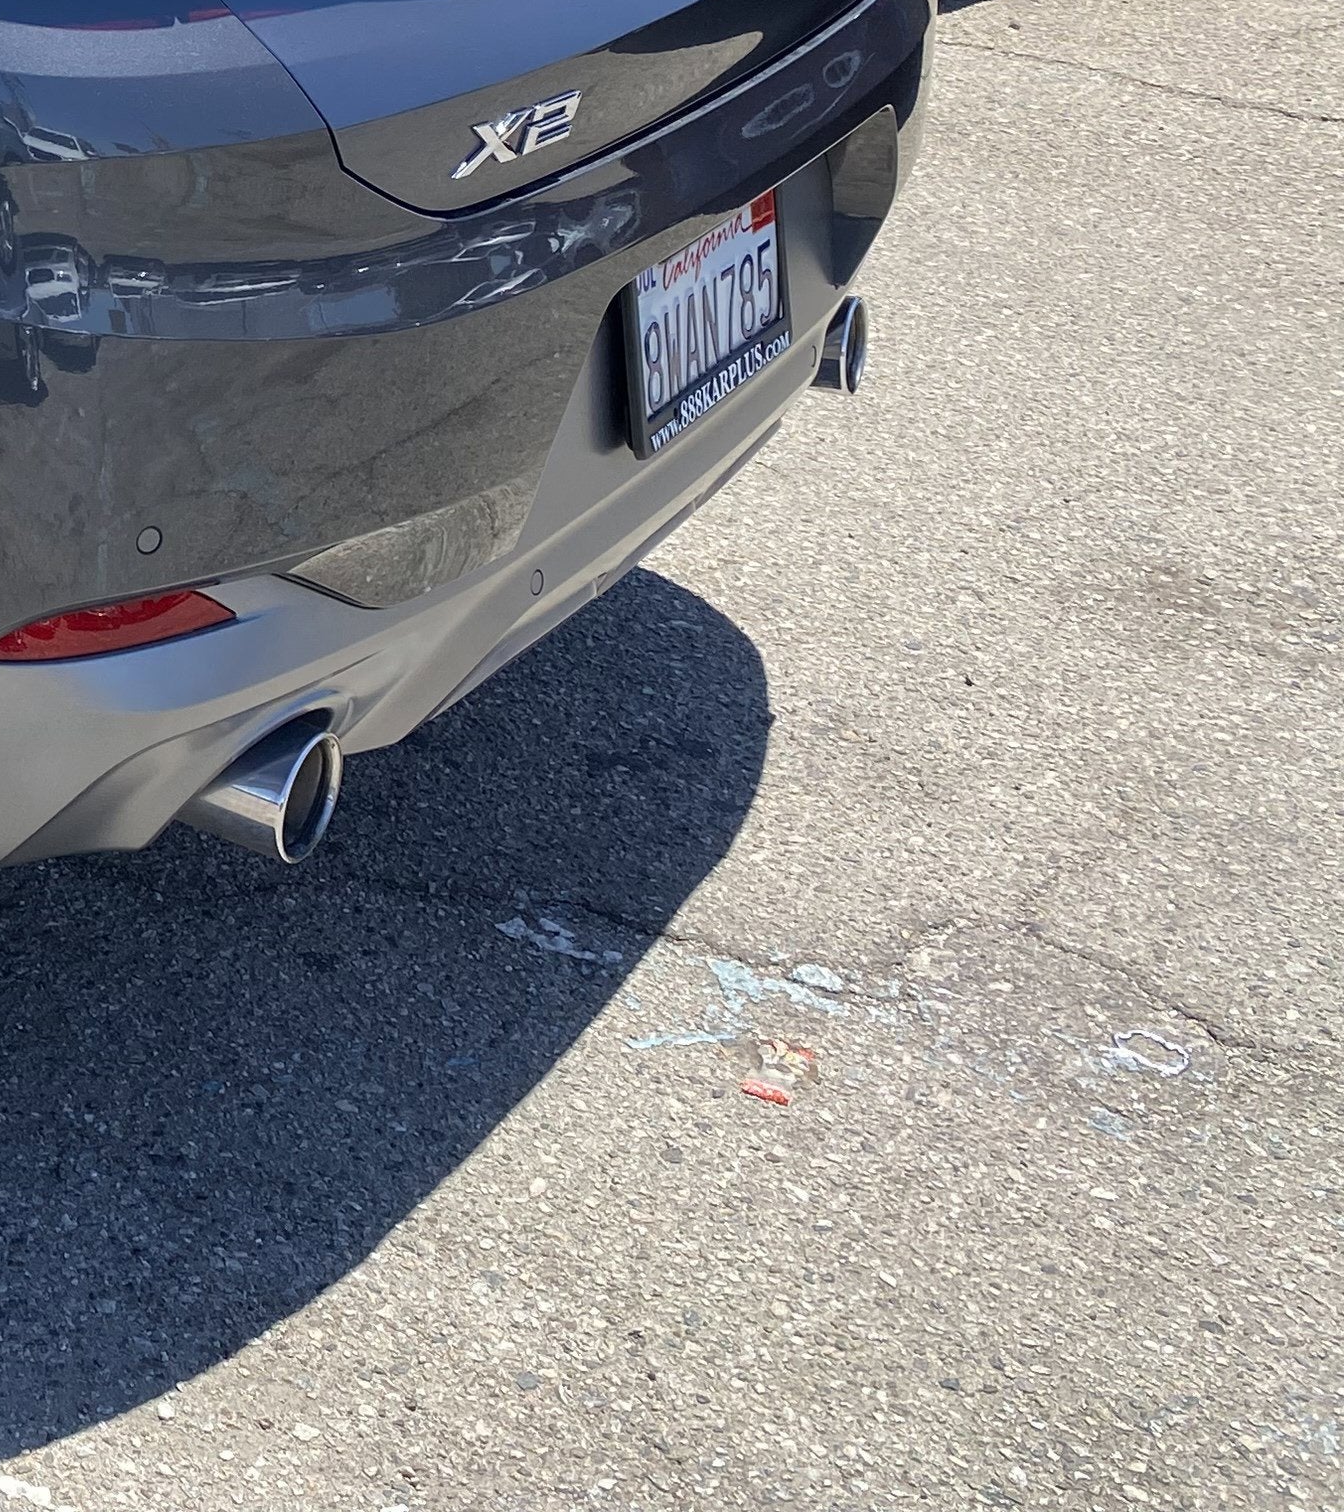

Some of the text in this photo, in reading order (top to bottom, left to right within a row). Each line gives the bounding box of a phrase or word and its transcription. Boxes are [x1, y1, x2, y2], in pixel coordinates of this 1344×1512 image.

[450, 88, 583, 180] X2
[662, 212, 754, 292] California
[644, 239, 773, 413] 8WAN785
